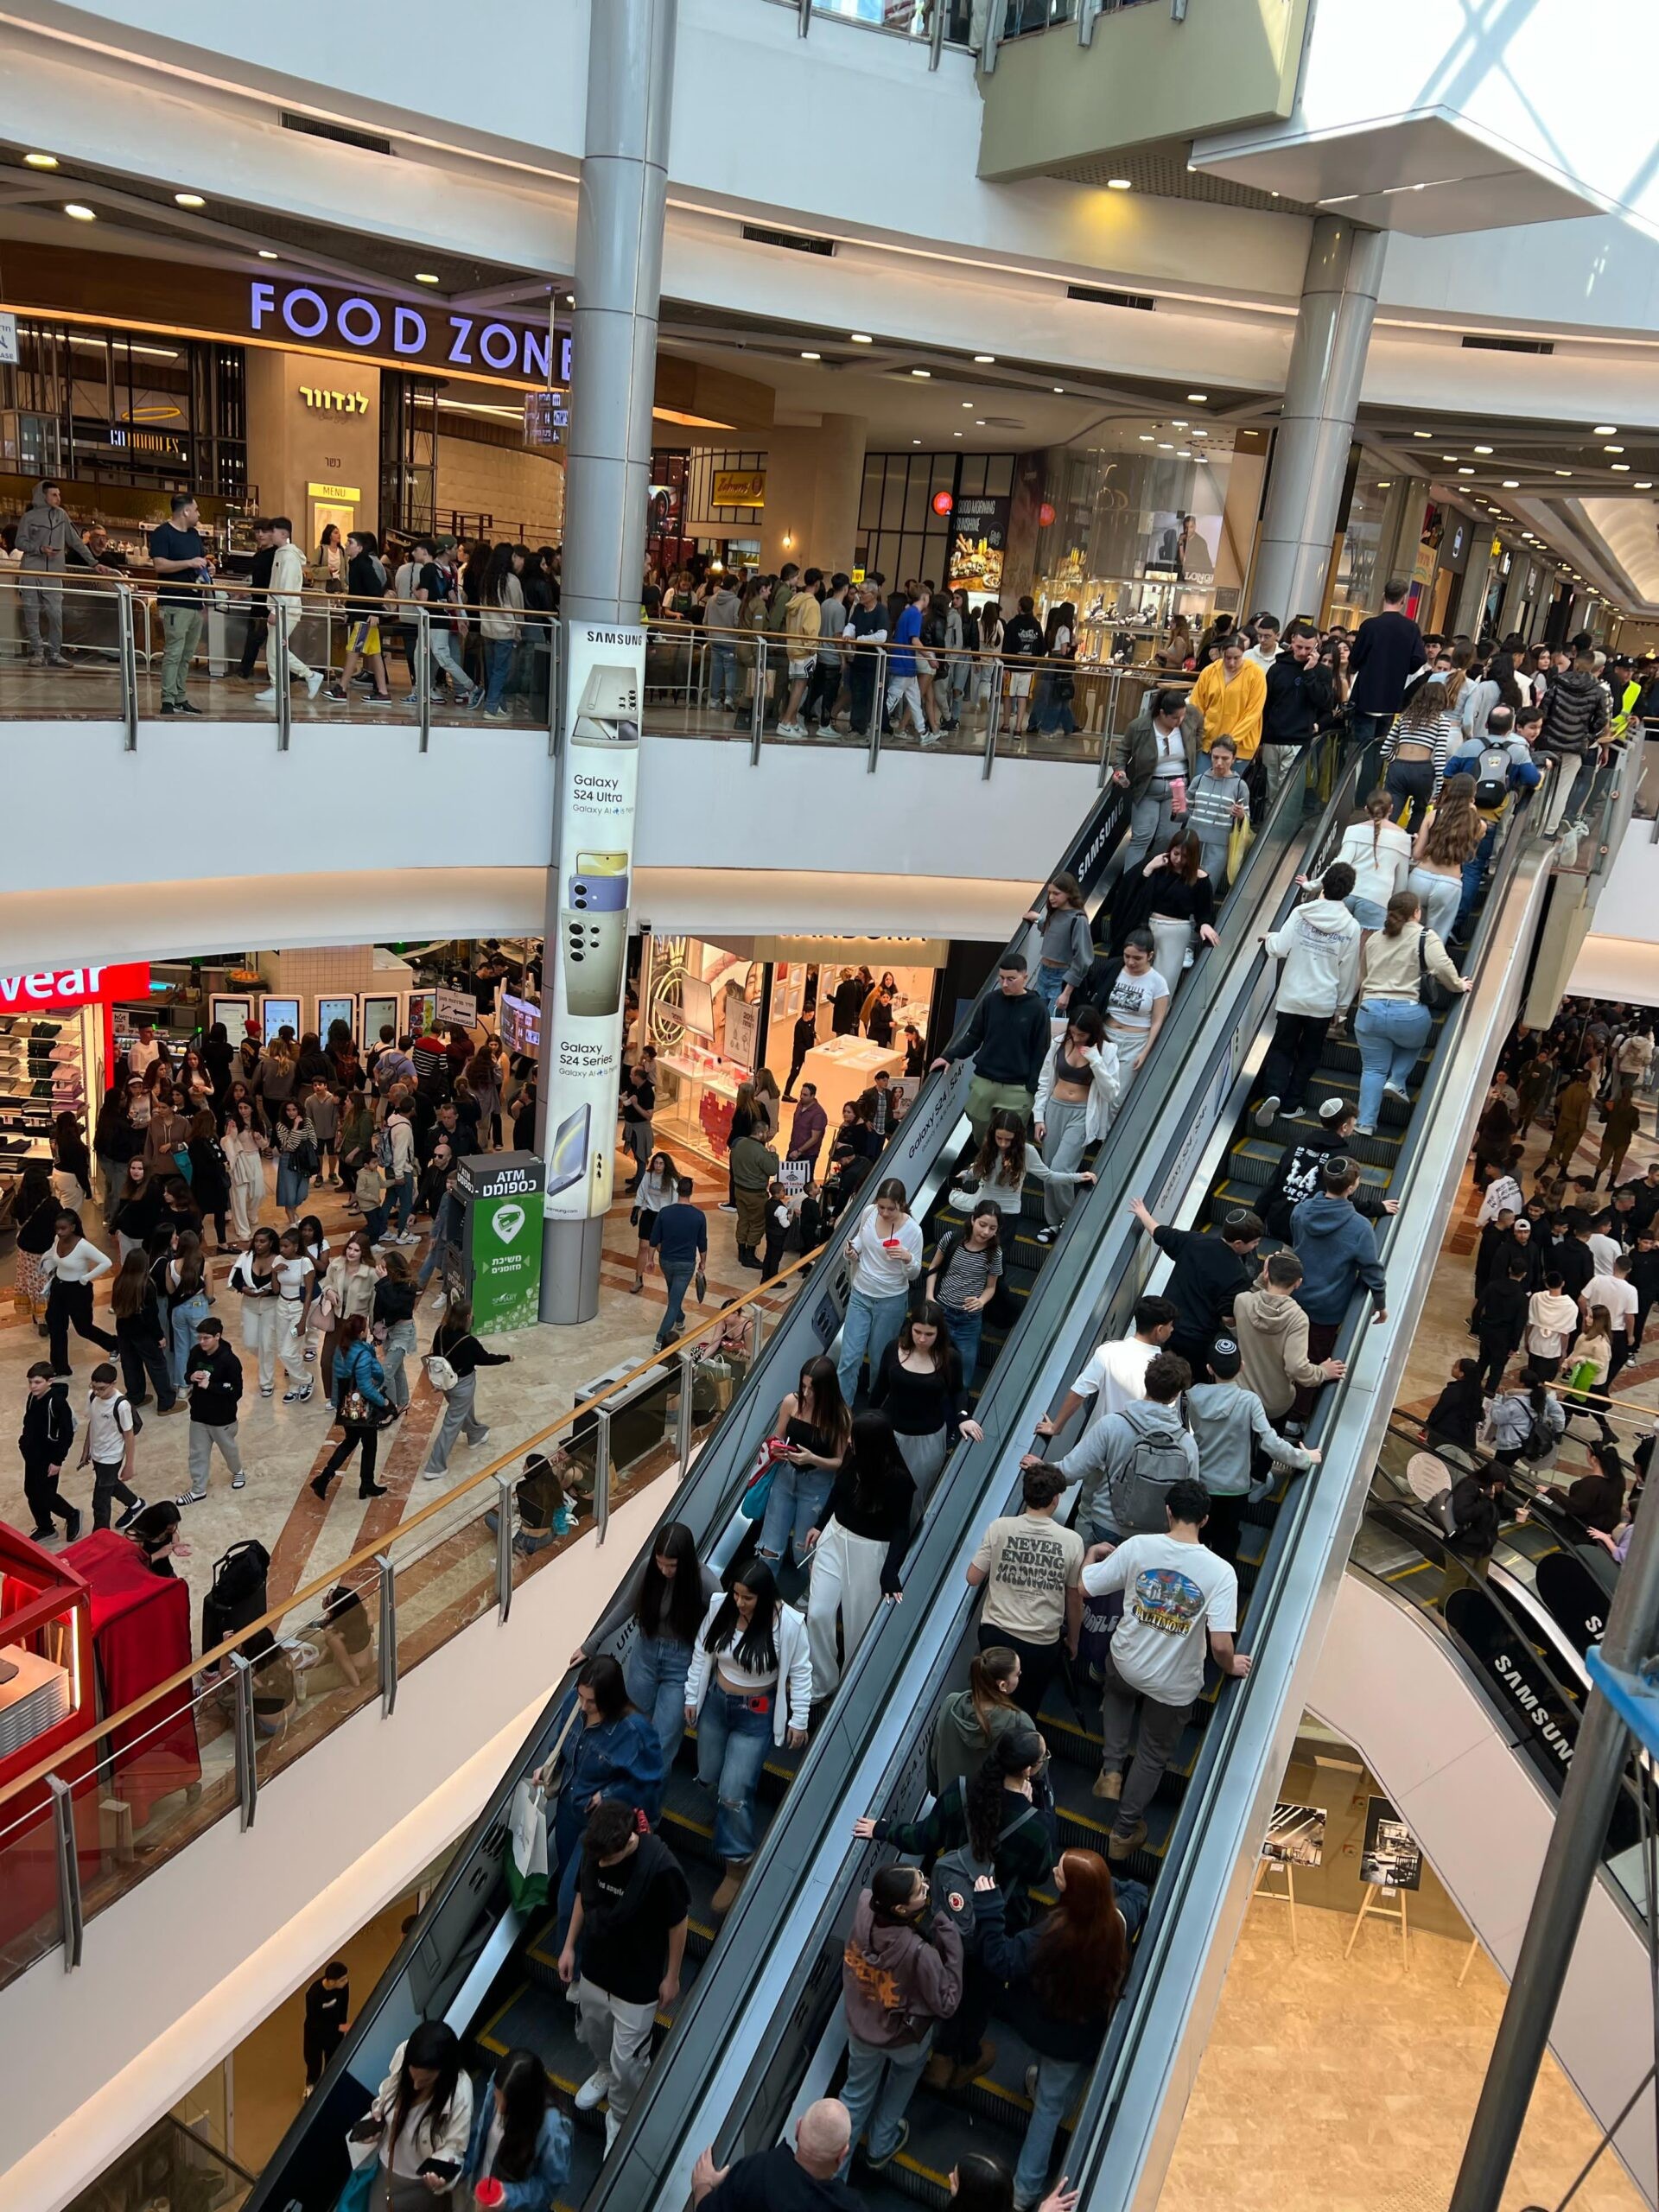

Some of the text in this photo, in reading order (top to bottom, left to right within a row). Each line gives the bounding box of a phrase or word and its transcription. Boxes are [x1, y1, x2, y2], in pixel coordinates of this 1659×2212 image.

[251, 282, 427, 354] FOOD
[299, 385, 370, 414] לנדוור
[324, 456, 341, 468] כשר
[322, 486, 346, 498] MENU
[587, 631, 642, 646] SAMSUNG
[574, 774, 619, 790] Galaxy
[573, 789, 622, 803] S24 Ultra
[572, 804, 602, 816] Galaxy
[1077, 796, 1123, 883] SAMSUNG
[560, 1041, 602, 1055] Galaxy
[559, 1054, 613, 1066] S24 Series
[559, 1067, 588, 1078] Galaxy
[909, 1114, 934, 1159] Galaxy
[934, 1090, 947, 1116] S24
[496, 1168, 525, 1183] ATM
[482, 1179, 537, 1197] כספומט
[491, 1263, 522, 1274] מזומנים
[492, 1255, 522, 1266] משיכת
[1007, 1535, 1063, 1557] NEVER
[1001, 1548, 1065, 1570] ENDING
[995, 1562, 1065, 1591] MADNESS
[1135, 1605, 1190, 1635] BALTIMORE
[616, 1618, 637, 1651] Ultr
[1494, 1655, 1577, 1770] SAMSUN
